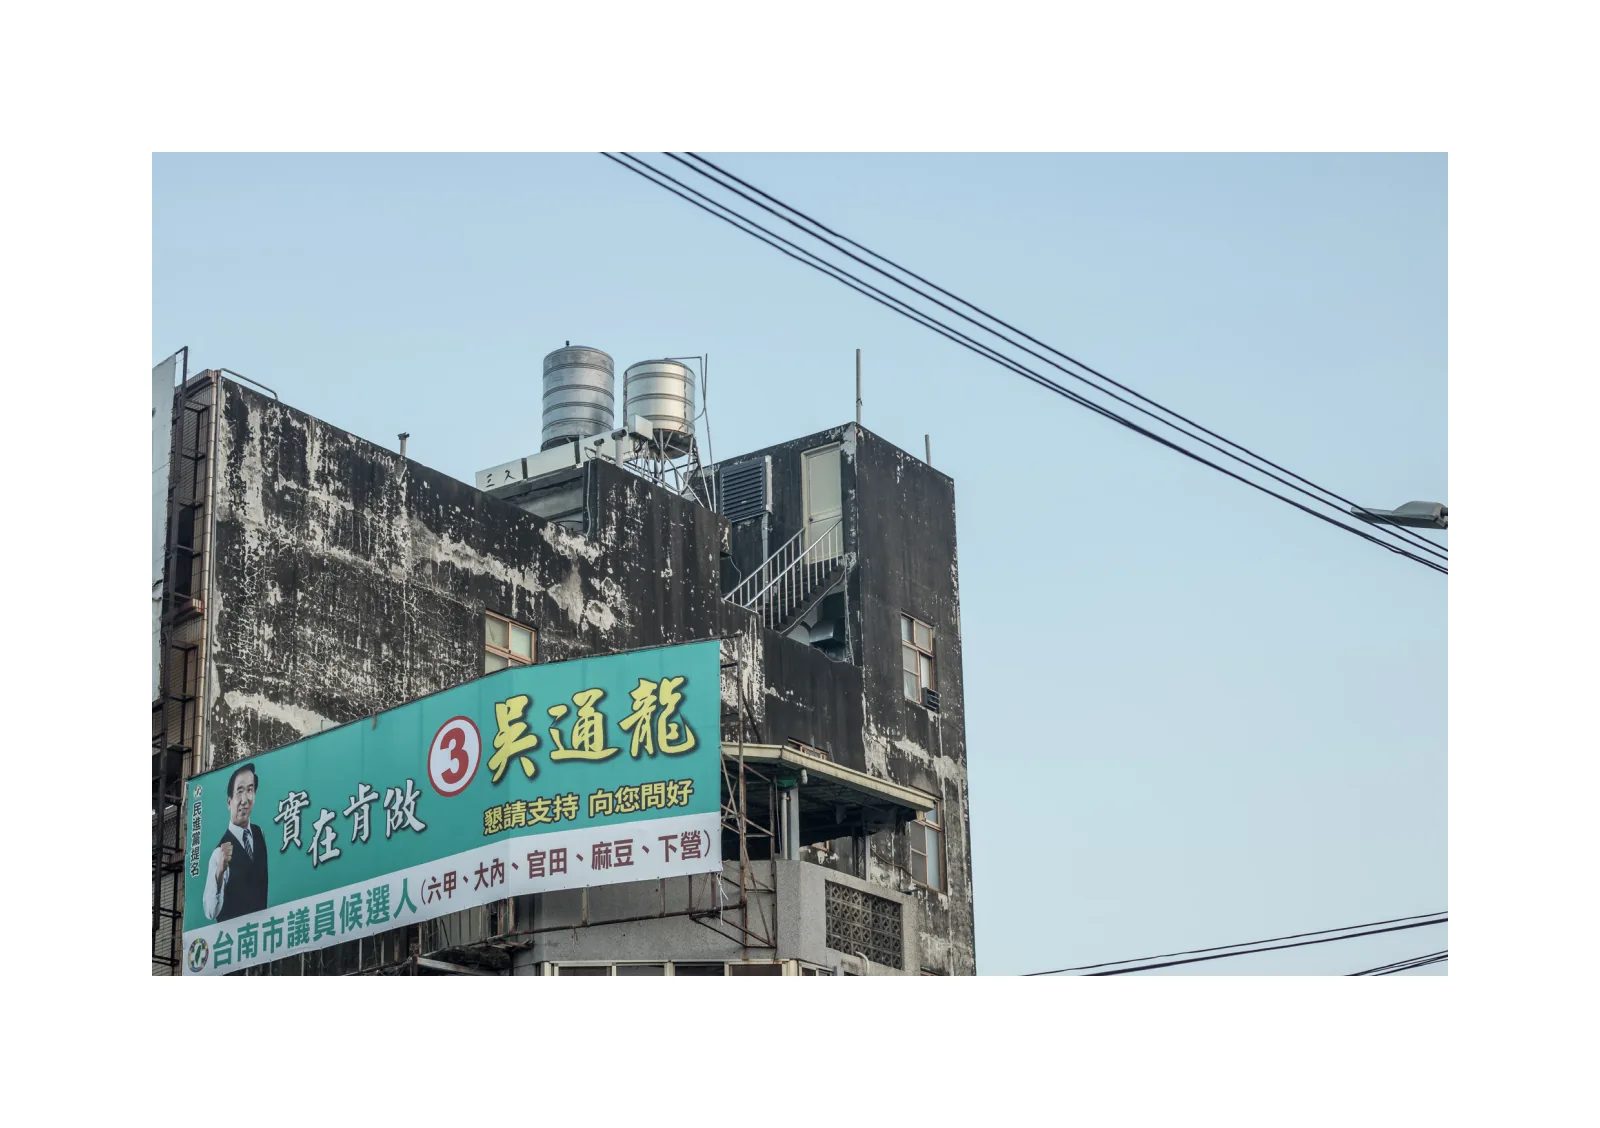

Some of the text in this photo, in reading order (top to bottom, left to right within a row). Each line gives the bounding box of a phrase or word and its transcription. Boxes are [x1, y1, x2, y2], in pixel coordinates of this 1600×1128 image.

[440, 727, 470, 785] 3
[487, 676, 696, 784] 吳通龍
[190, 801, 202, 877] 民進黨提名
[273, 778, 427, 868] 實在肯做
[483, 778, 695, 836] 懇請支持 向您問好
[212, 877, 418, 970] 台南市議員候選人
